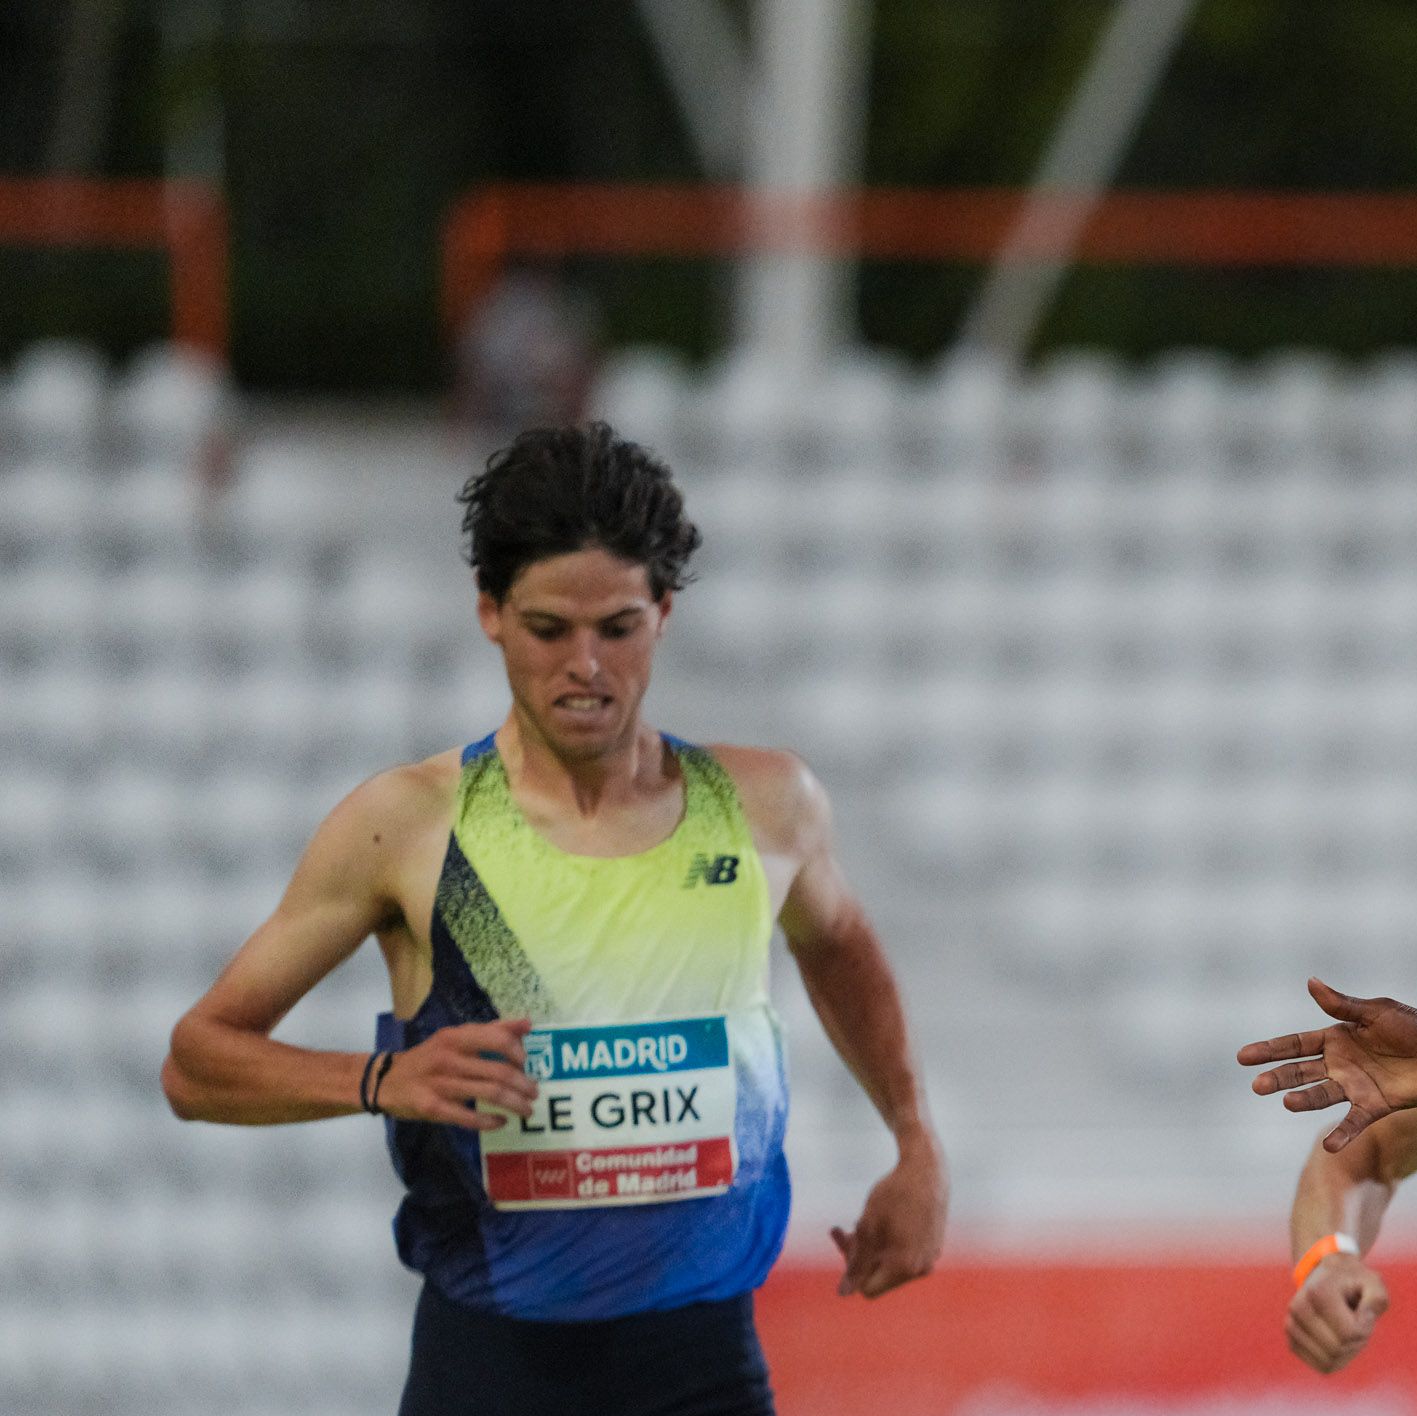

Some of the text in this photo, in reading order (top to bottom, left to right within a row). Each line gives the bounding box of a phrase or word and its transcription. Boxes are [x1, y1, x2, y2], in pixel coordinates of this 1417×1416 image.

[561, 1035, 688, 1071] MADRID
[591, 1086, 701, 1129] GRIX
[576, 1146, 698, 1173] Comunidad
[577, 1168, 698, 1197] de Madrid
